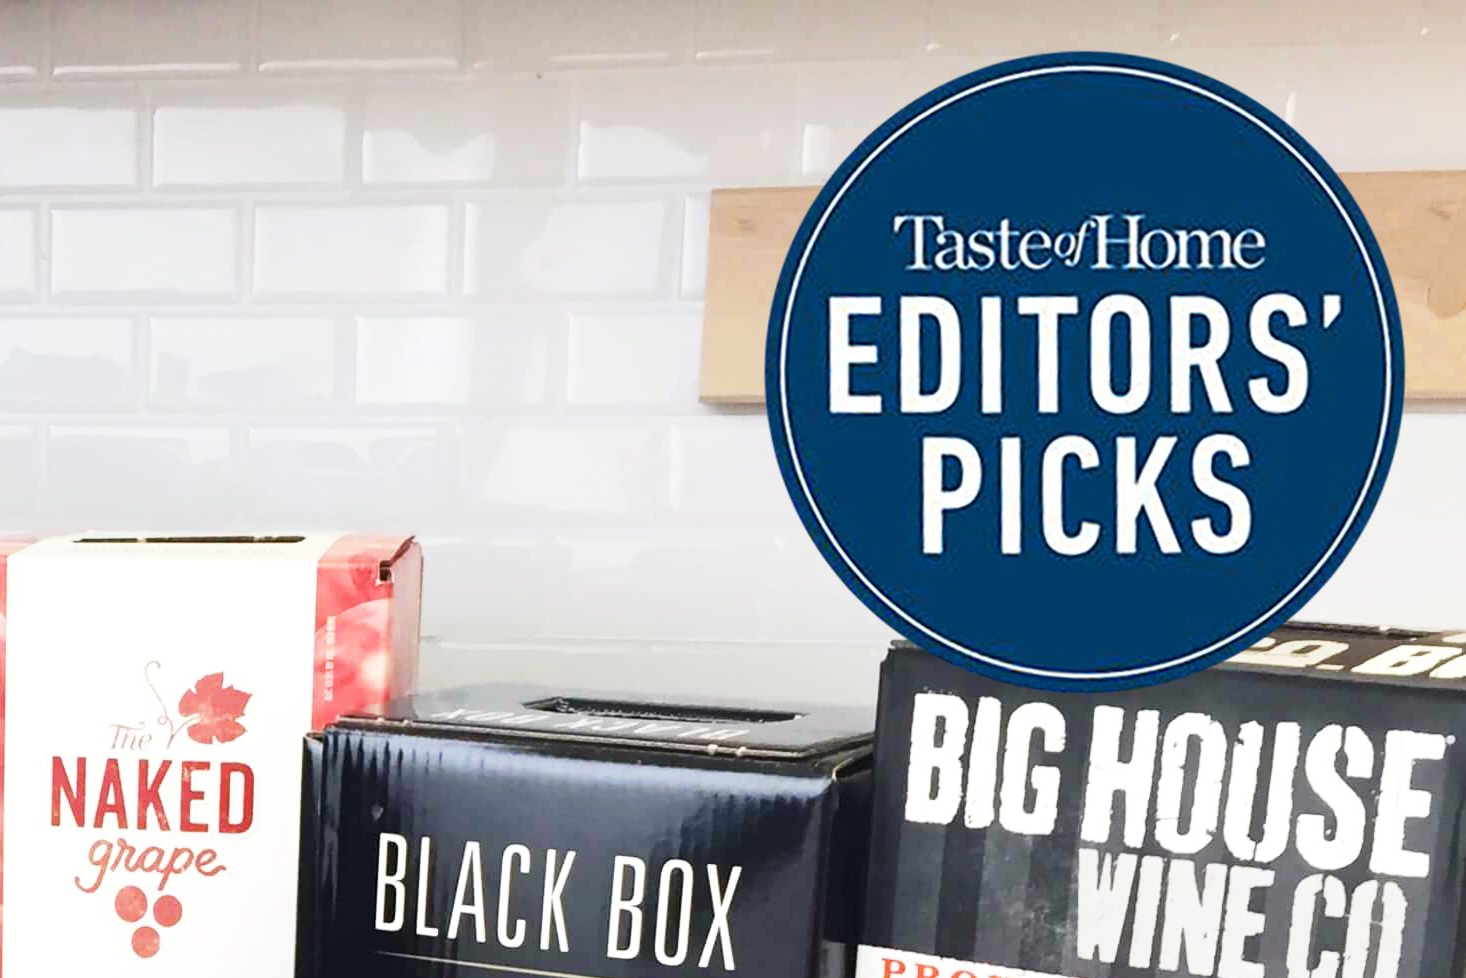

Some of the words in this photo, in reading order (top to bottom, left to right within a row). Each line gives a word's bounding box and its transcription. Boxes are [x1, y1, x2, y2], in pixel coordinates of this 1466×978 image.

[109, 721, 153, 751] The
[51, 756, 255, 834] NAKED
[904, 691, 1067, 836] BIG
[1080, 703, 1448, 878] HOUSE
[74, 838, 227, 893] grape
[375, 832, 576, 953] BLACK
[605, 855, 743, 971] BOX
